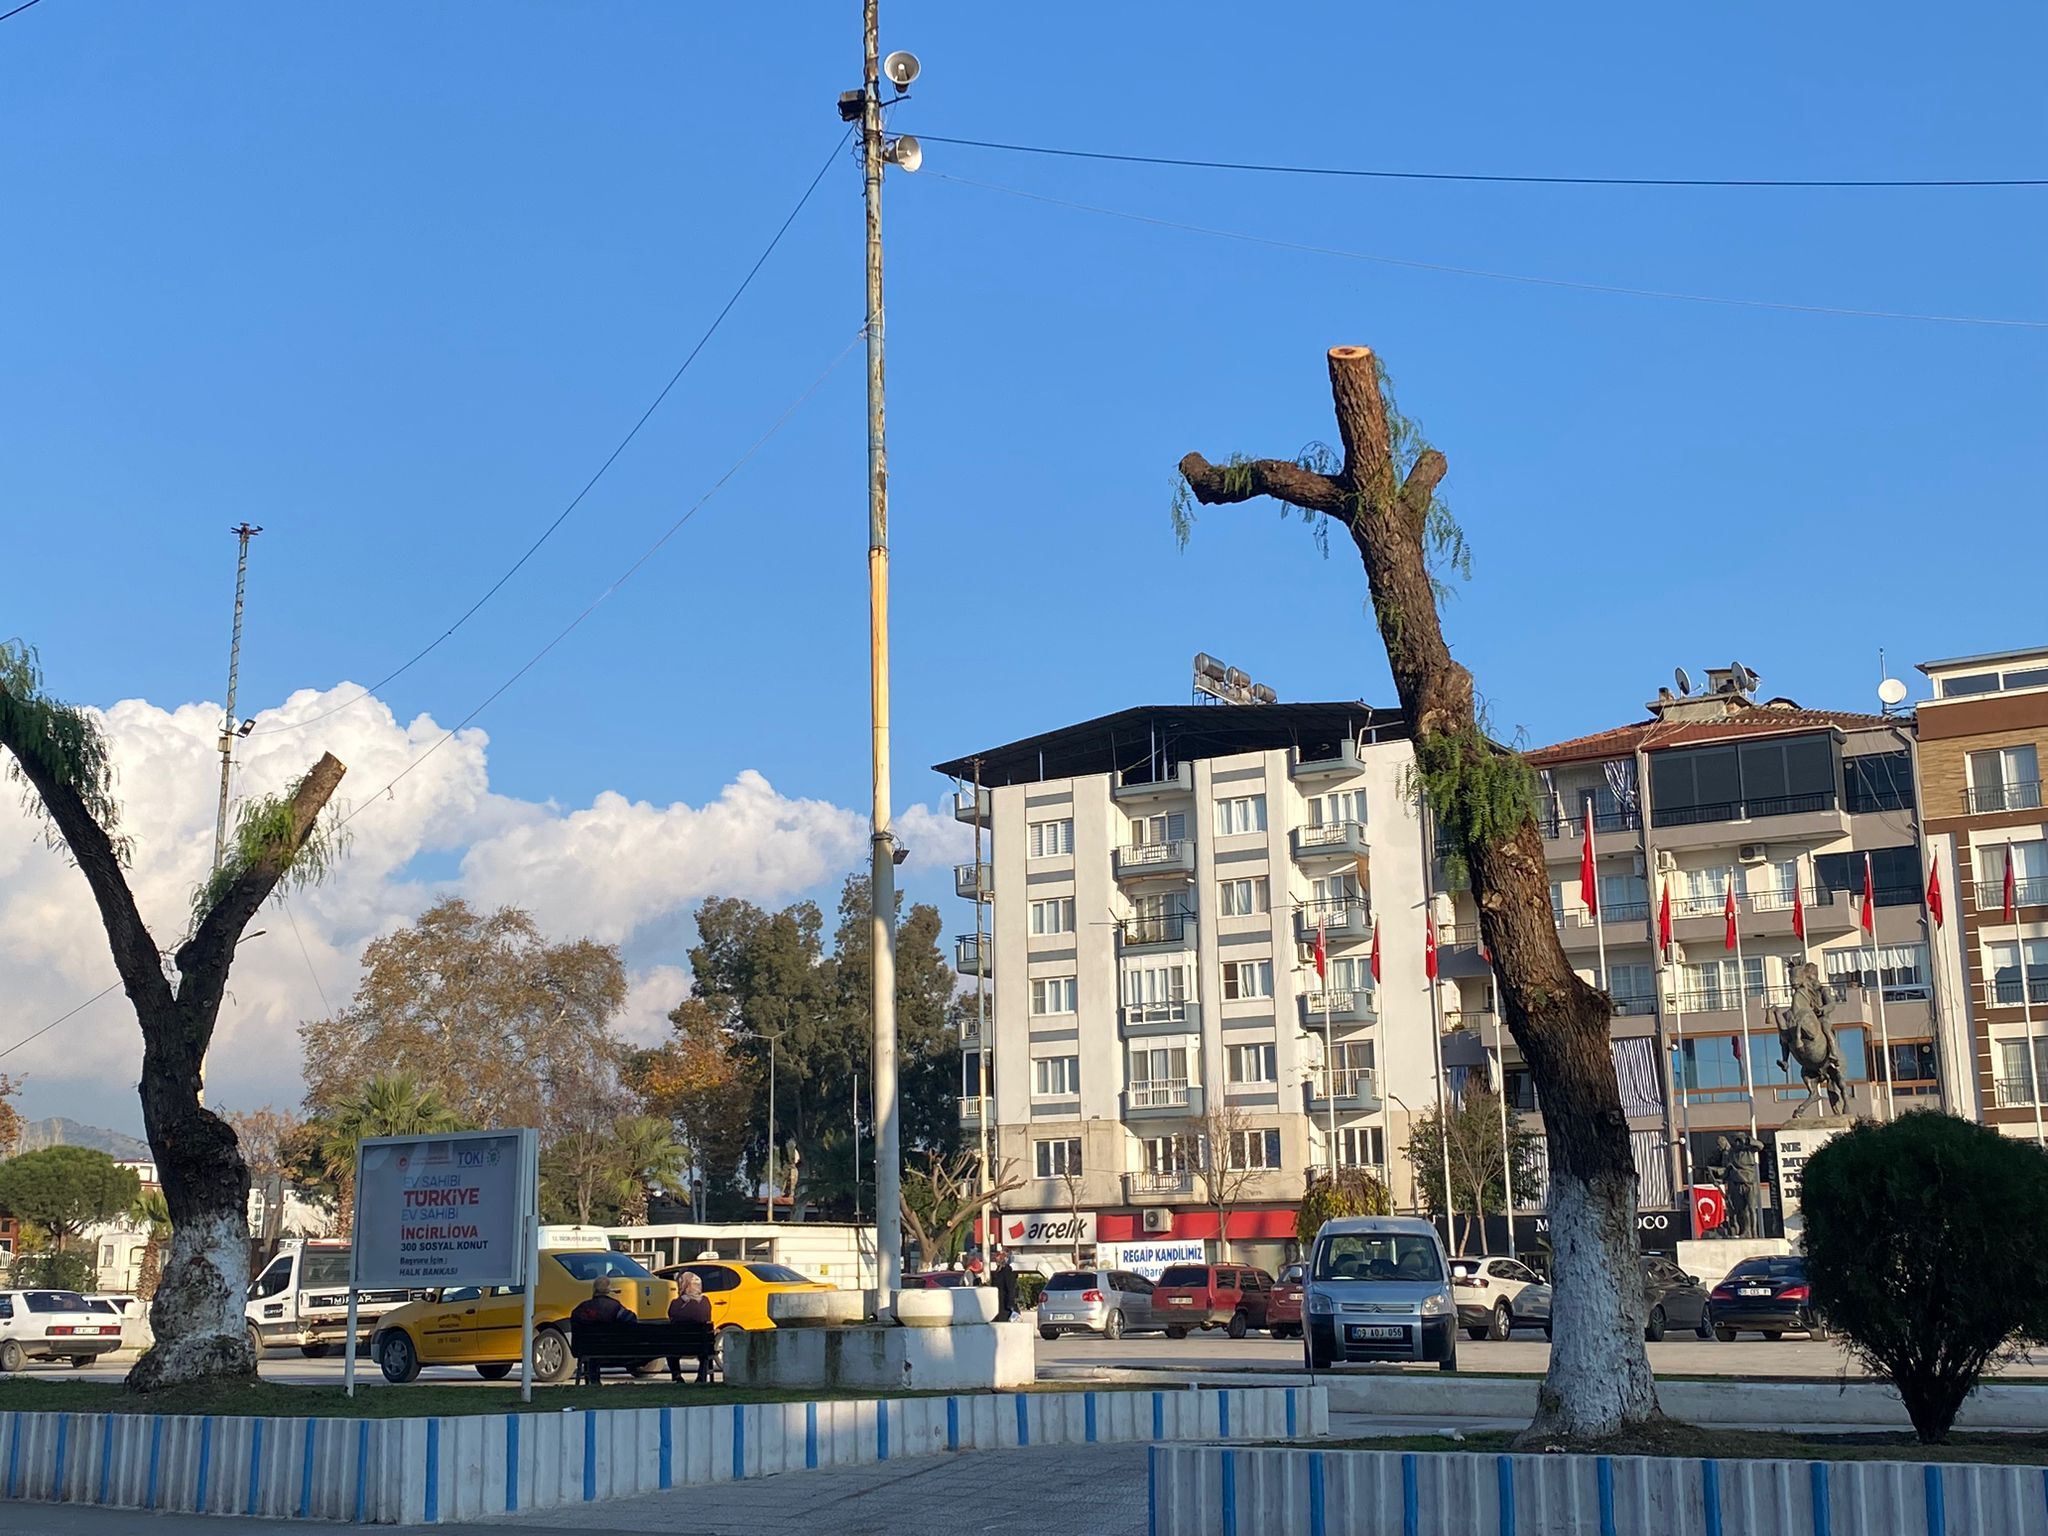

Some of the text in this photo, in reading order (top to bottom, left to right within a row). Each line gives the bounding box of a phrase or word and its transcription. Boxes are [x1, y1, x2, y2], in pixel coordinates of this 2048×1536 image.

[1780, 1142, 1801, 1152] NE
[403, 1176, 419, 1189] EV
[403, 1187, 480, 1208] TÜRKİYE
[401, 1208, 418, 1221] EV
[401, 1224, 478, 1241] İNCİRLİOVA
[1028, 1218, 1088, 1243] arçelik
[401, 1240, 488, 1252] 300 SOSYAL KONUT
[1123, 1244, 1203, 1263] REGAİP KANDİLİMİZ
[1357, 1328, 1367, 1338] 09
[1387, 1327, 1402, 1337] 056
